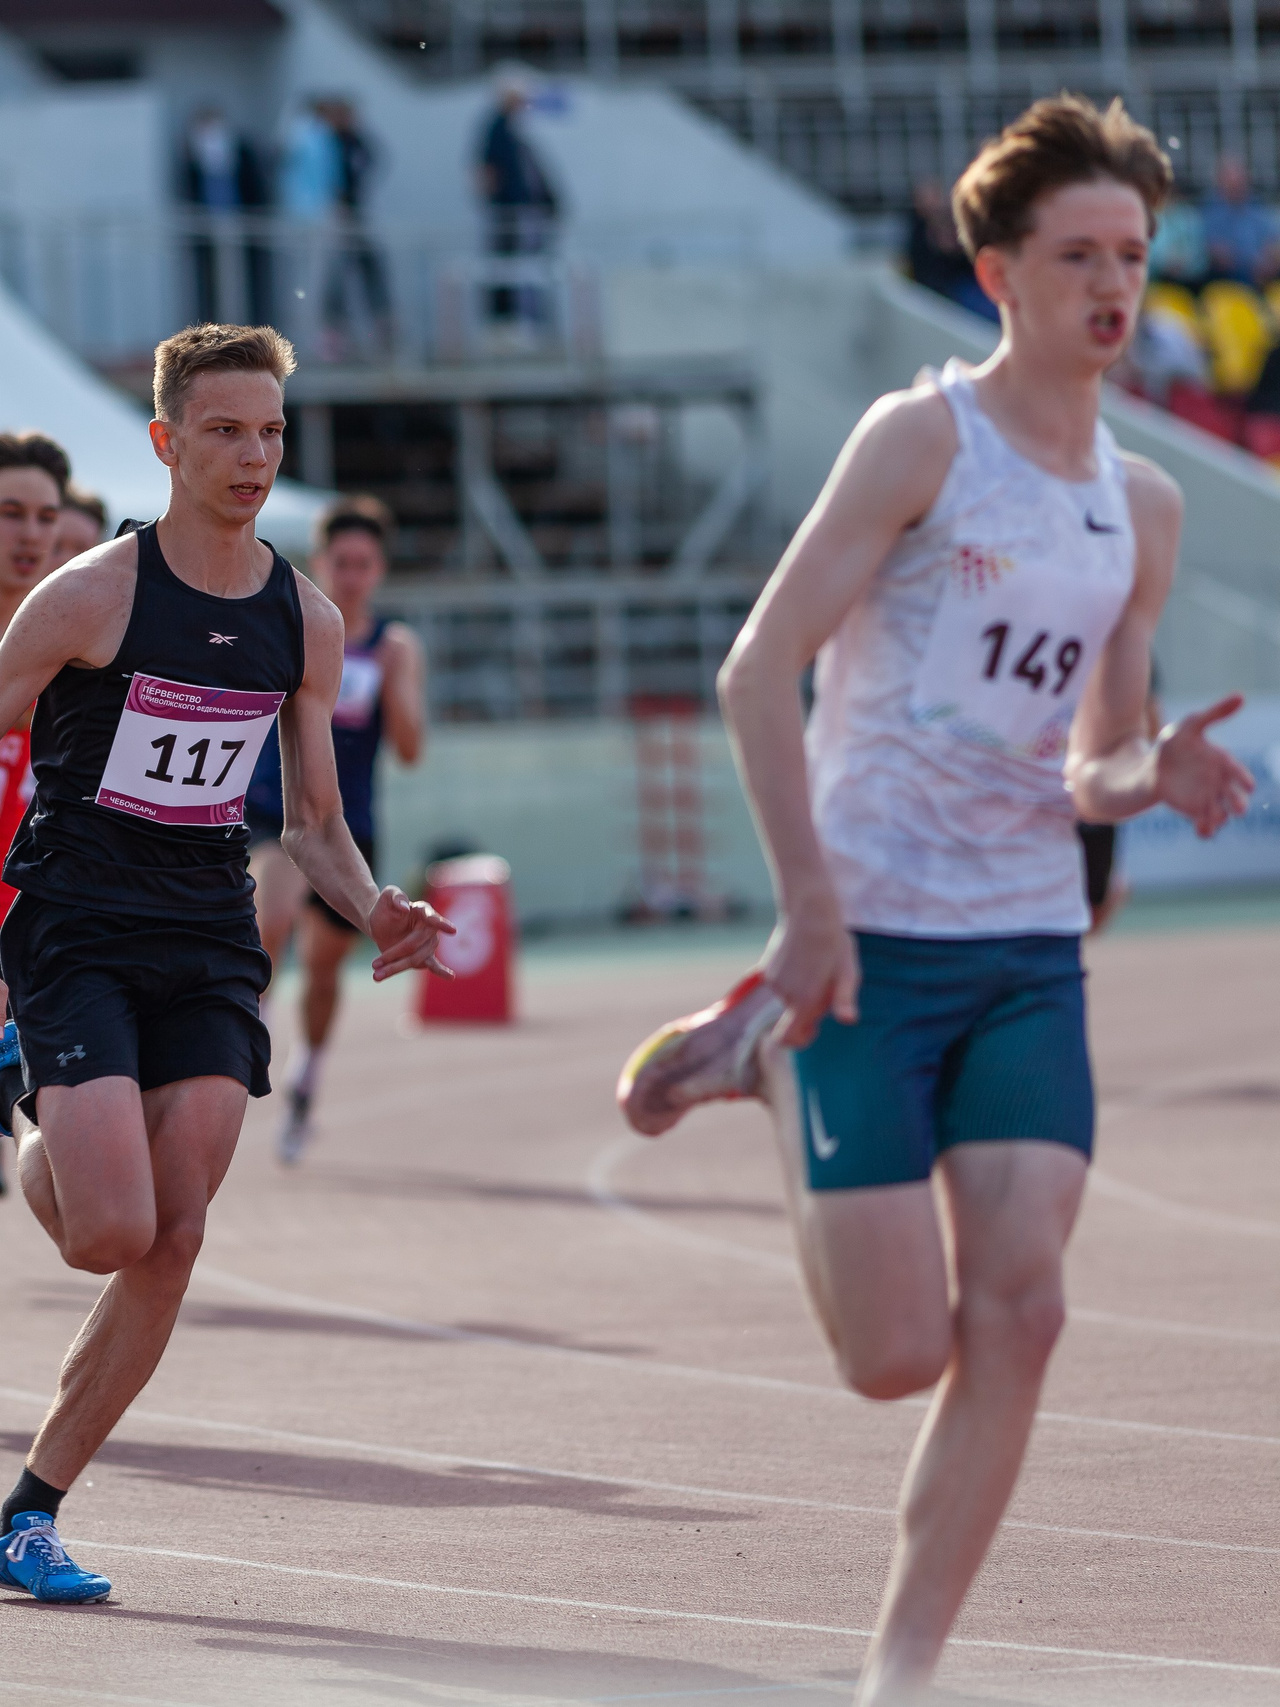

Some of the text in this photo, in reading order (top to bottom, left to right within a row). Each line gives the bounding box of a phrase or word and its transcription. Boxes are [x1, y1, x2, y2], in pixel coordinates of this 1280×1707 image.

[981, 620, 1083, 696] 149
[140, 694, 263, 717] ПРИВОЛЖСКОГО ФЕДЕРАЛЬНОГО ОКРУГА
[142, 685, 202, 704] ПЕРВЕНСТВО
[145, 733, 246, 787] 117
[109, 796, 157, 816] ЧЕБОКСАРЫ
